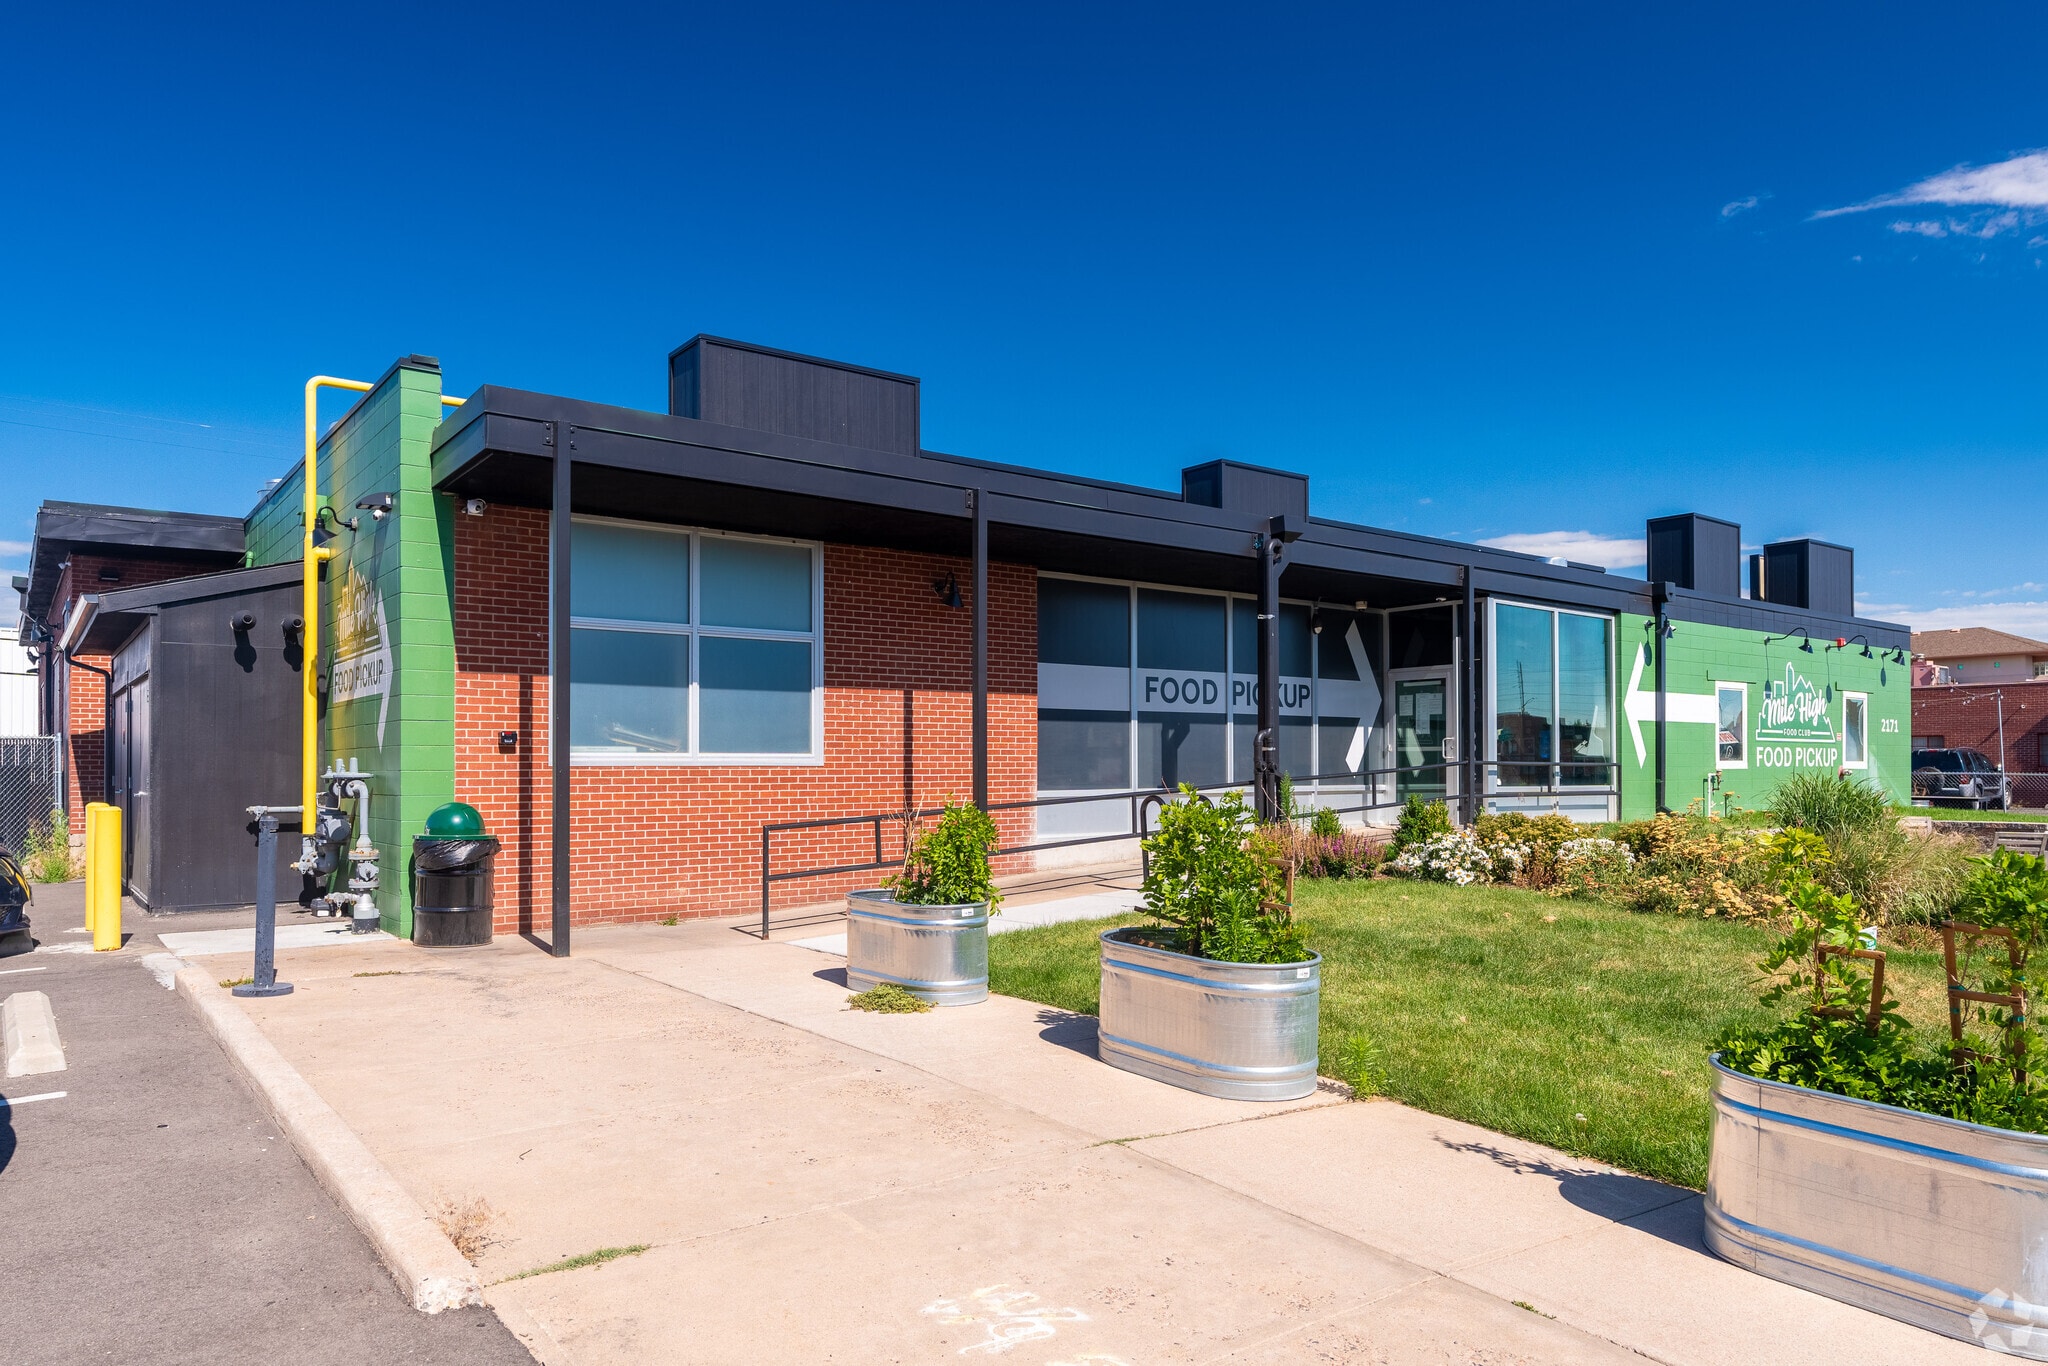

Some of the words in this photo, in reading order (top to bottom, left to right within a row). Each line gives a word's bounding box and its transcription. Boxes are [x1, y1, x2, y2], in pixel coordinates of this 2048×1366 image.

[335, 667, 354, 695] FOOD
[355, 658, 384, 690] PICKUP
[1145, 676, 1218, 705] FOOD
[1762, 694, 1795, 728] Mile
[1794, 688, 1827, 727] High
[1783, 728, 1797, 736] FOOD
[1798, 729, 1811, 737] CLUB
[1881, 718, 1899, 732] 2171
[1756, 747, 1793, 767] FOOD
[1795, 747, 1838, 768] PICKUP
